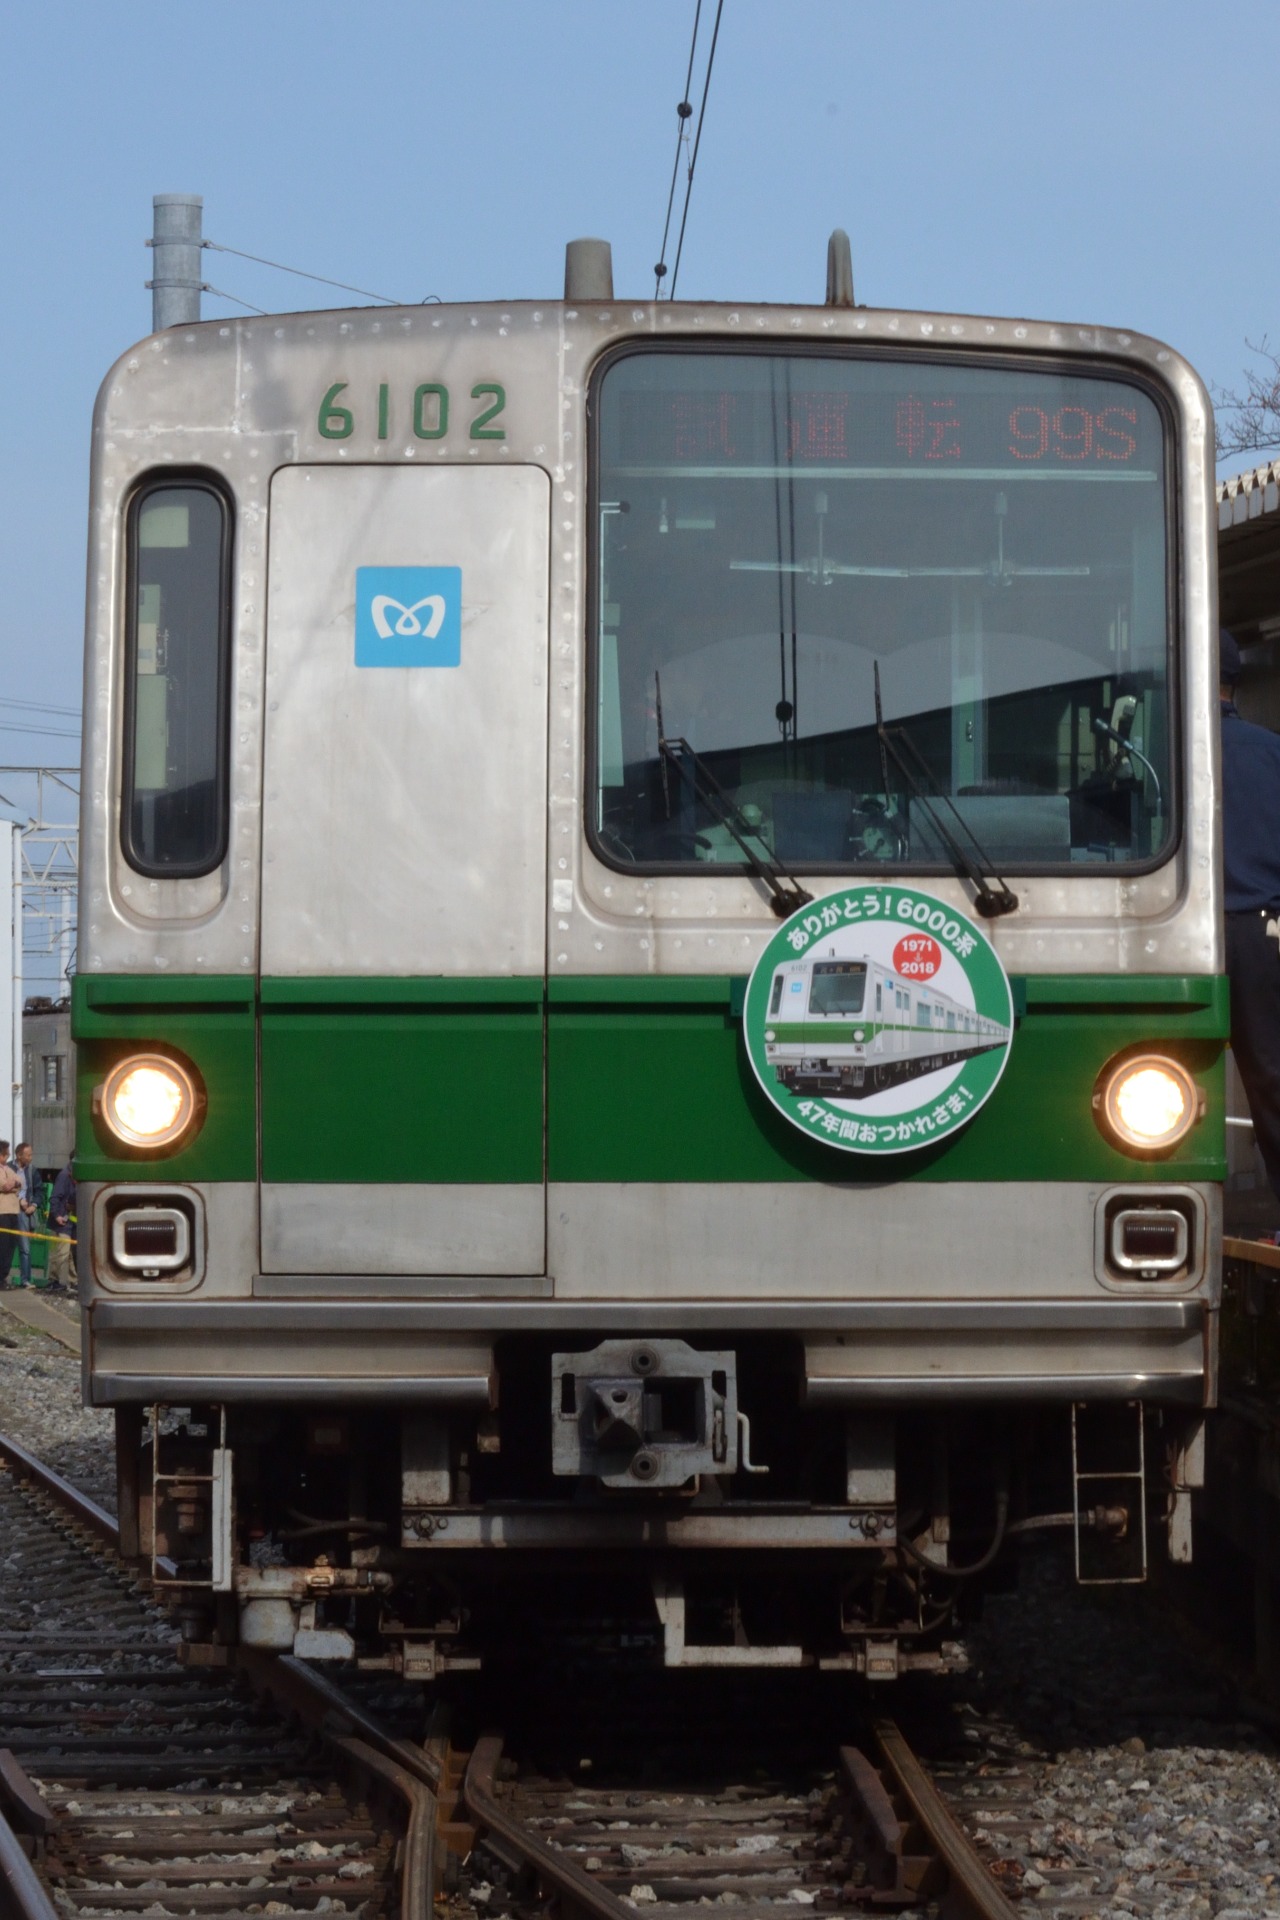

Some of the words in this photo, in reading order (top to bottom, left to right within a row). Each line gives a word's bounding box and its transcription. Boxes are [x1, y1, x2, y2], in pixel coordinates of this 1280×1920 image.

[317, 383, 506, 440] 6102
[1008, 406, 1137, 461] 99S
[902, 940, 932, 952] 1971
[901, 962, 934, 974] 2018
